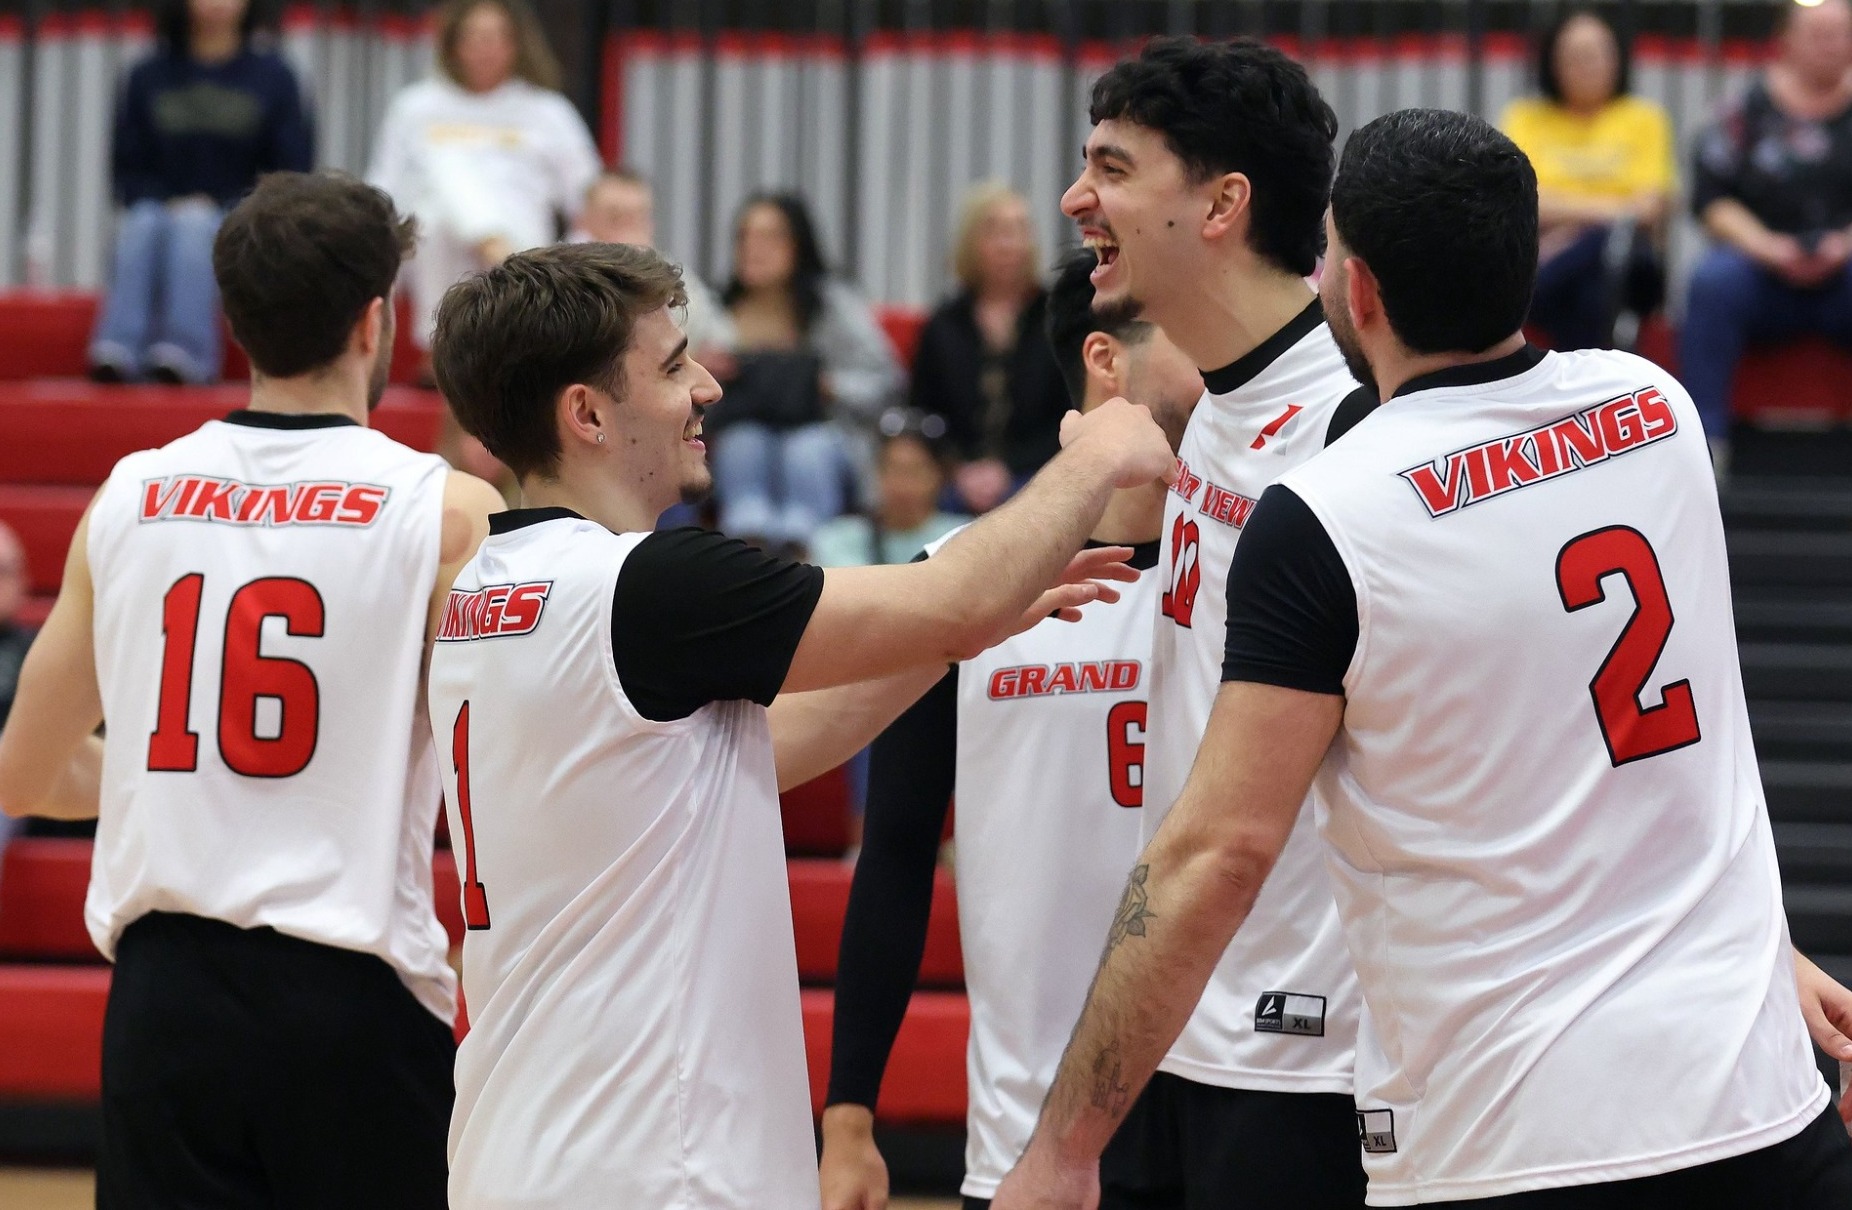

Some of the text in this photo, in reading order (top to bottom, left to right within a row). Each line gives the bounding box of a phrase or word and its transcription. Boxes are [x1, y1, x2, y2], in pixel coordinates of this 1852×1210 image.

[1397, 385, 1679, 520] VIKINGS
[139, 474, 392, 529] VIKINGS
[1199, 481, 1257, 530] VIEW
[147, 572, 325, 778] 16
[987, 659, 1142, 701] GRAND
[1555, 524, 1702, 768] 2
[1107, 701, 1147, 808] 6
[452, 699, 491, 930] 1
[1292, 1017, 1312, 1030] XL
[1373, 1135, 1387, 1147] XL
